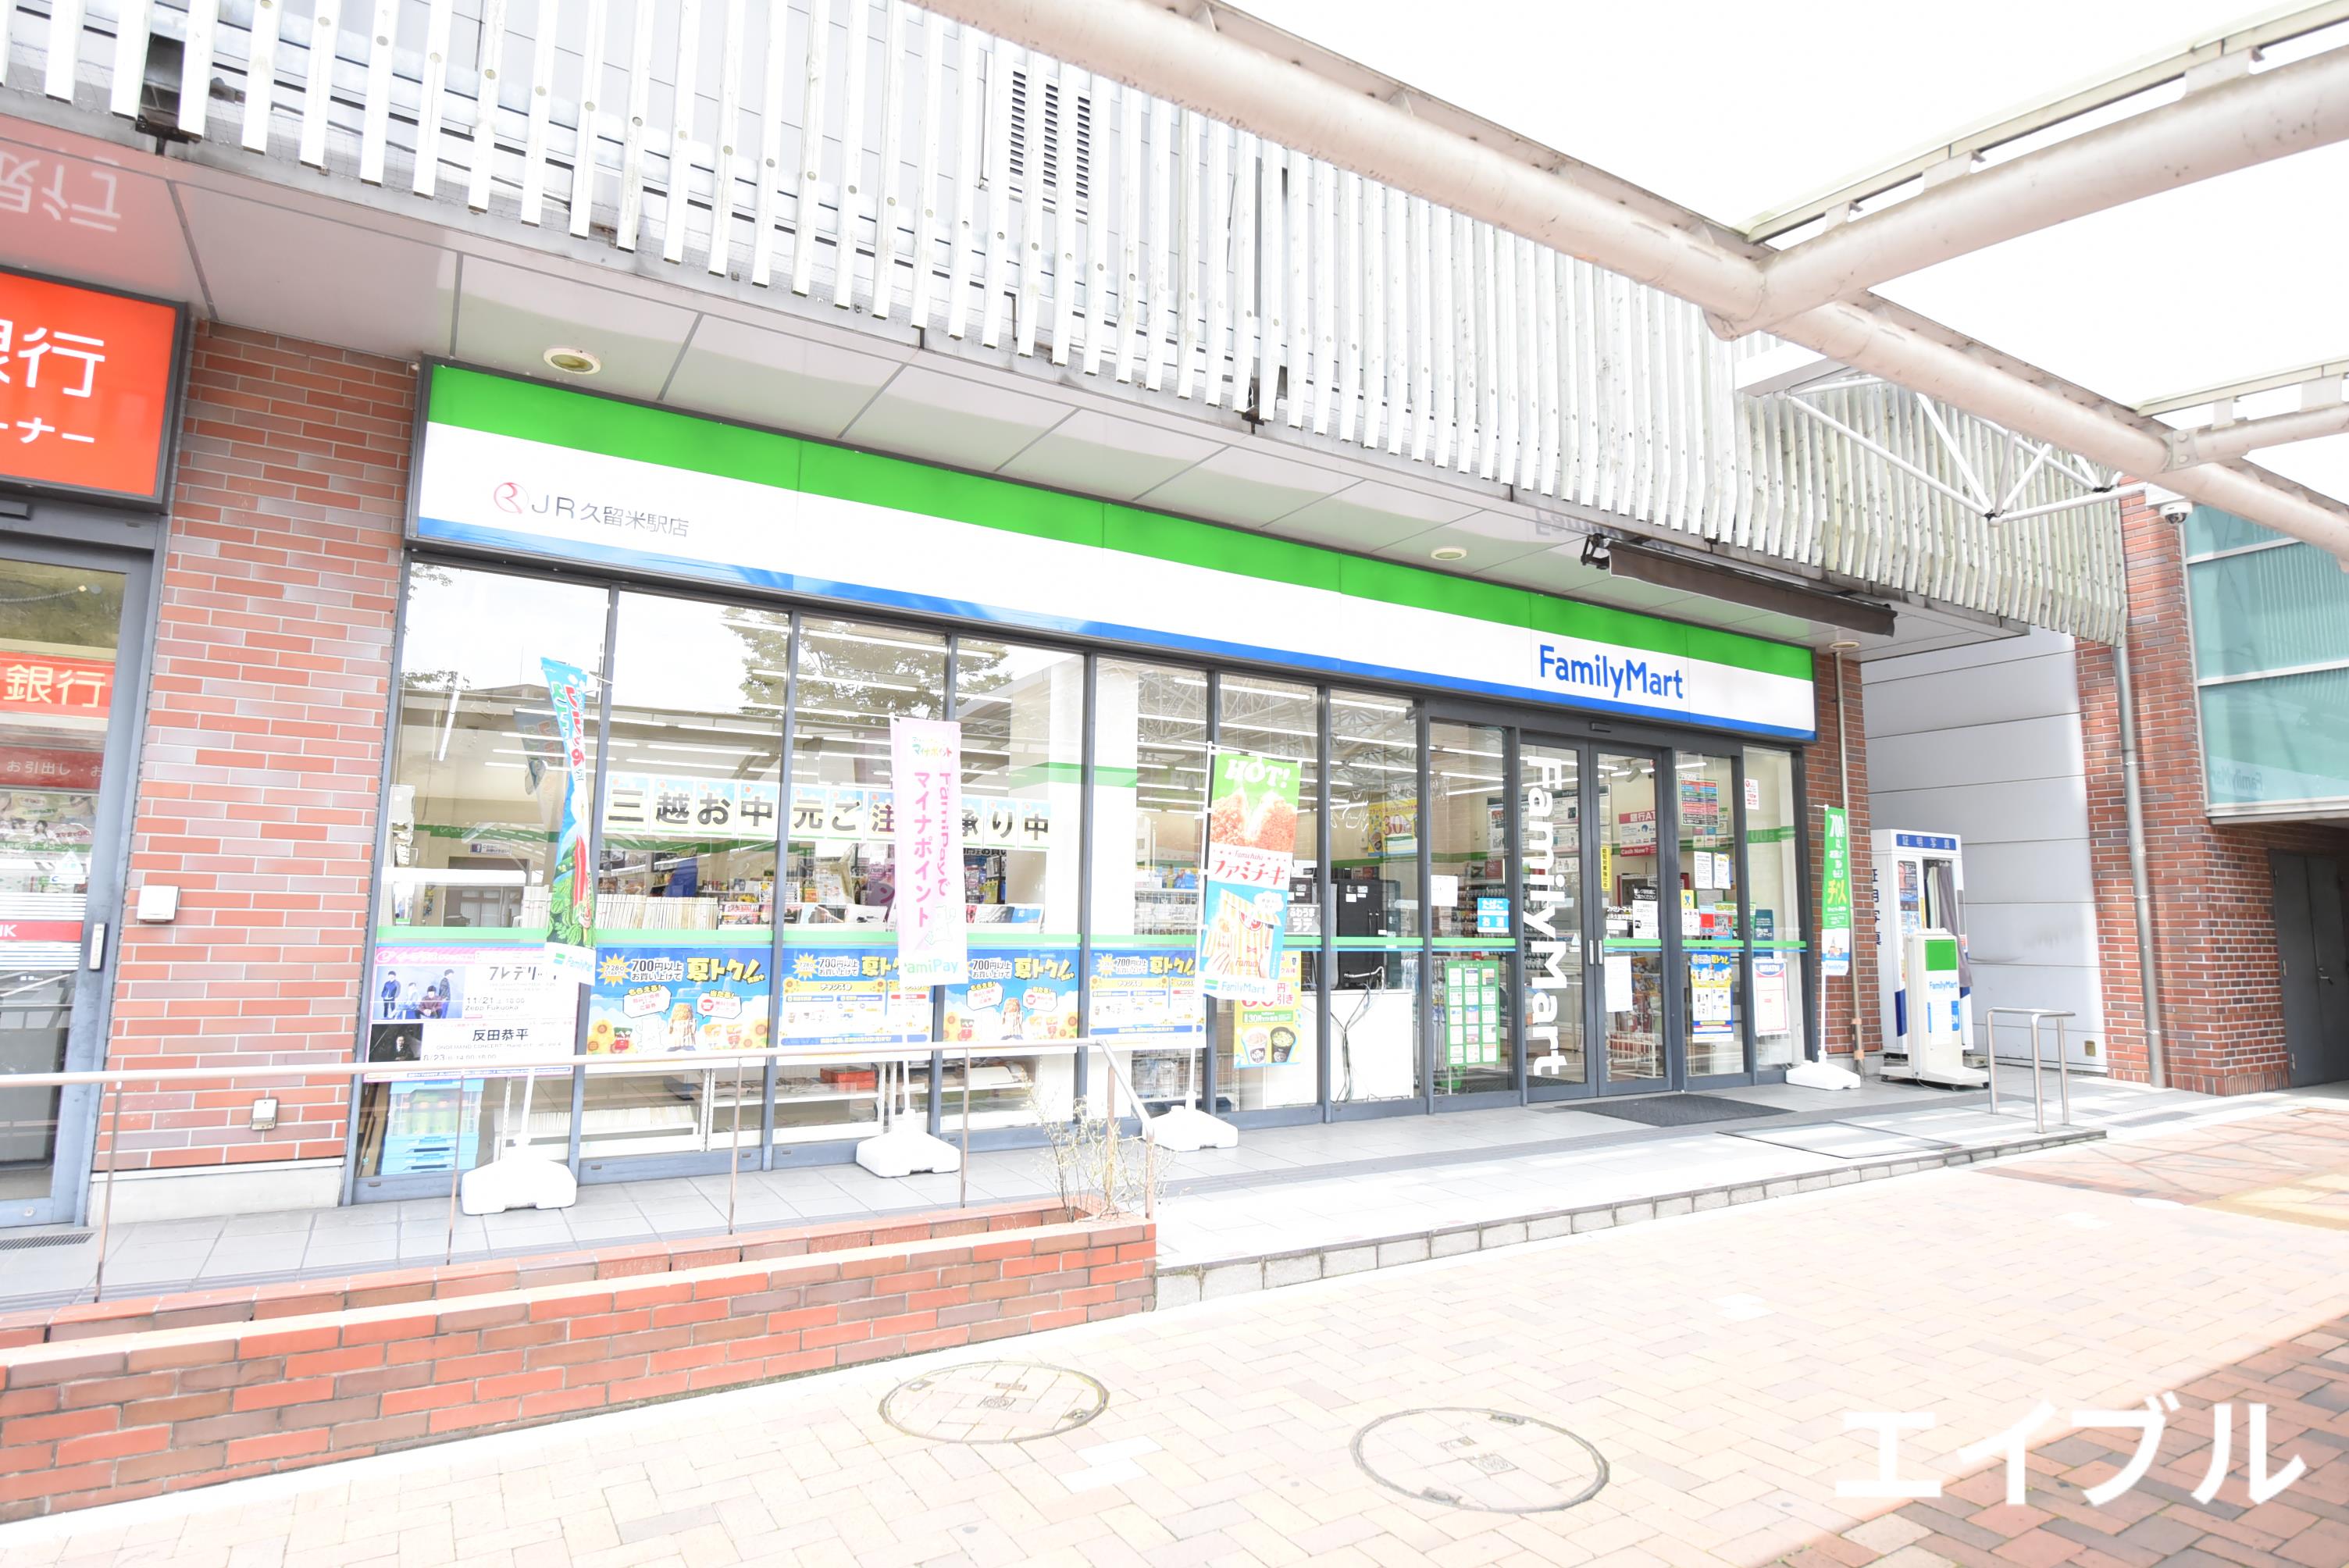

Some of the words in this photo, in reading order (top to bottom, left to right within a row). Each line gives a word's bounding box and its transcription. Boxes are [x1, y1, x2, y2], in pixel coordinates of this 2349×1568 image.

[1538, 643, 1684, 700] FamilyMart
[4, 664, 106, 707] 銀行
[1224, 758, 1291, 789] HOT!
[607, 789, 1049, 841] 三越お中元ご注承り中
[914, 772, 932, 928] マイナポイント
[1213, 860, 1285, 886] ファミチキ
[1292, 918, 1314, 932] ラテ
[1522, 755, 1567, 1077] FamilyMart
[631, 960, 683, 971] 700円以上
[686, 957, 761, 982] 夏トク!
[818, 958, 858, 968] 700円以上
[904, 958, 959, 974] amiPay
[972, 960, 1011, 970] 700円以上
[1014, 957, 1071, 980] 夏トク!
[1117, 957, 1147, 967] 700円以上
[1221, 981, 1267, 996] FamilyMart
[1929, 980, 1958, 990] FamilyMart
[472, 1028, 529, 1042] 反田恭平
